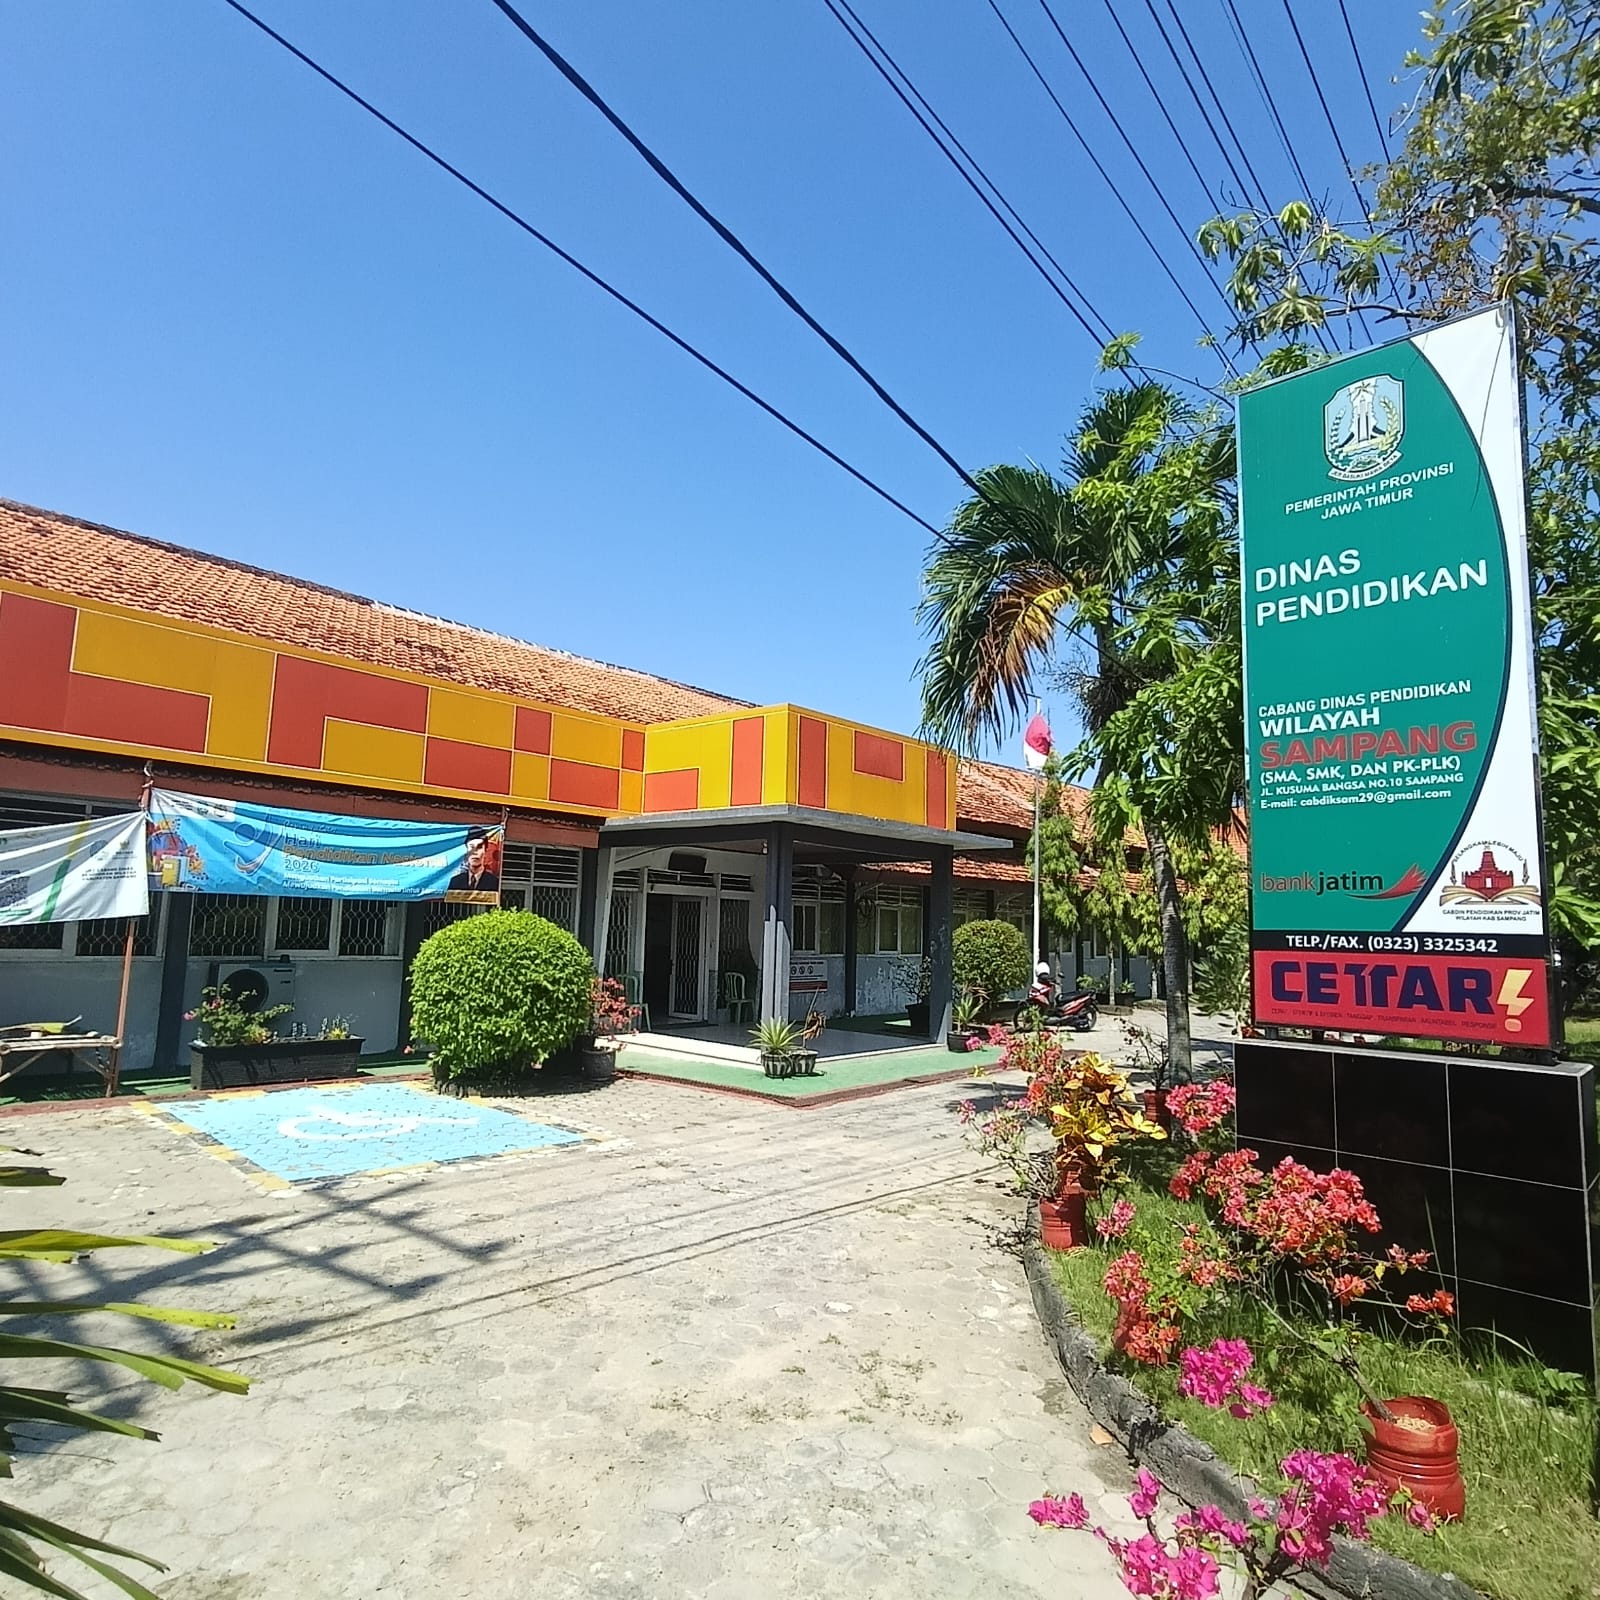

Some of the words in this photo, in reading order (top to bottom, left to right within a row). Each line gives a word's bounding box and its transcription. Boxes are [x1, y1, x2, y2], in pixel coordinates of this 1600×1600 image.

[1285, 482, 1376, 515] PEMERINTAH
[1380, 462, 1454, 492] PROVINSI
[1320, 501, 1362, 520] JAWA
[1365, 488, 1413, 509] TIMUR
[1255, 549, 1361, 593] DINAS
[1256, 559, 1488, 627] PENDIDIKAN
[1258, 699, 1316, 718] CABANG
[1320, 694, 1366, 711] DINAS
[1370, 680, 1472, 704] PENDIDIKAN
[1259, 706, 1380, 737] WILAYAH
[1259, 721, 1477, 769] SAMPANG
[1260, 770, 1302, 786] (SMA,
[1306, 765, 1345, 782] SMK,
[1351, 761, 1387, 777] DAN
[1393, 755, 1461, 773] PK-PLK)
[1276, 783, 1319, 796] KUSUMA
[1322, 780, 1366, 792] BANGSA
[1368, 777, 1403, 790] NO.10
[1406, 773, 1464, 787] SAMPANG
[1260, 798, 1297, 809] E-mail:
[1300, 787, 1452, 808] cabdiksam29@gmail.com
[1261, 870, 1384, 896] bankjatim
[1286, 934, 1364, 950] TELP./FAX.
[1367, 935, 1419, 953] (0323)
[1423, 937, 1499, 953] 3325342
